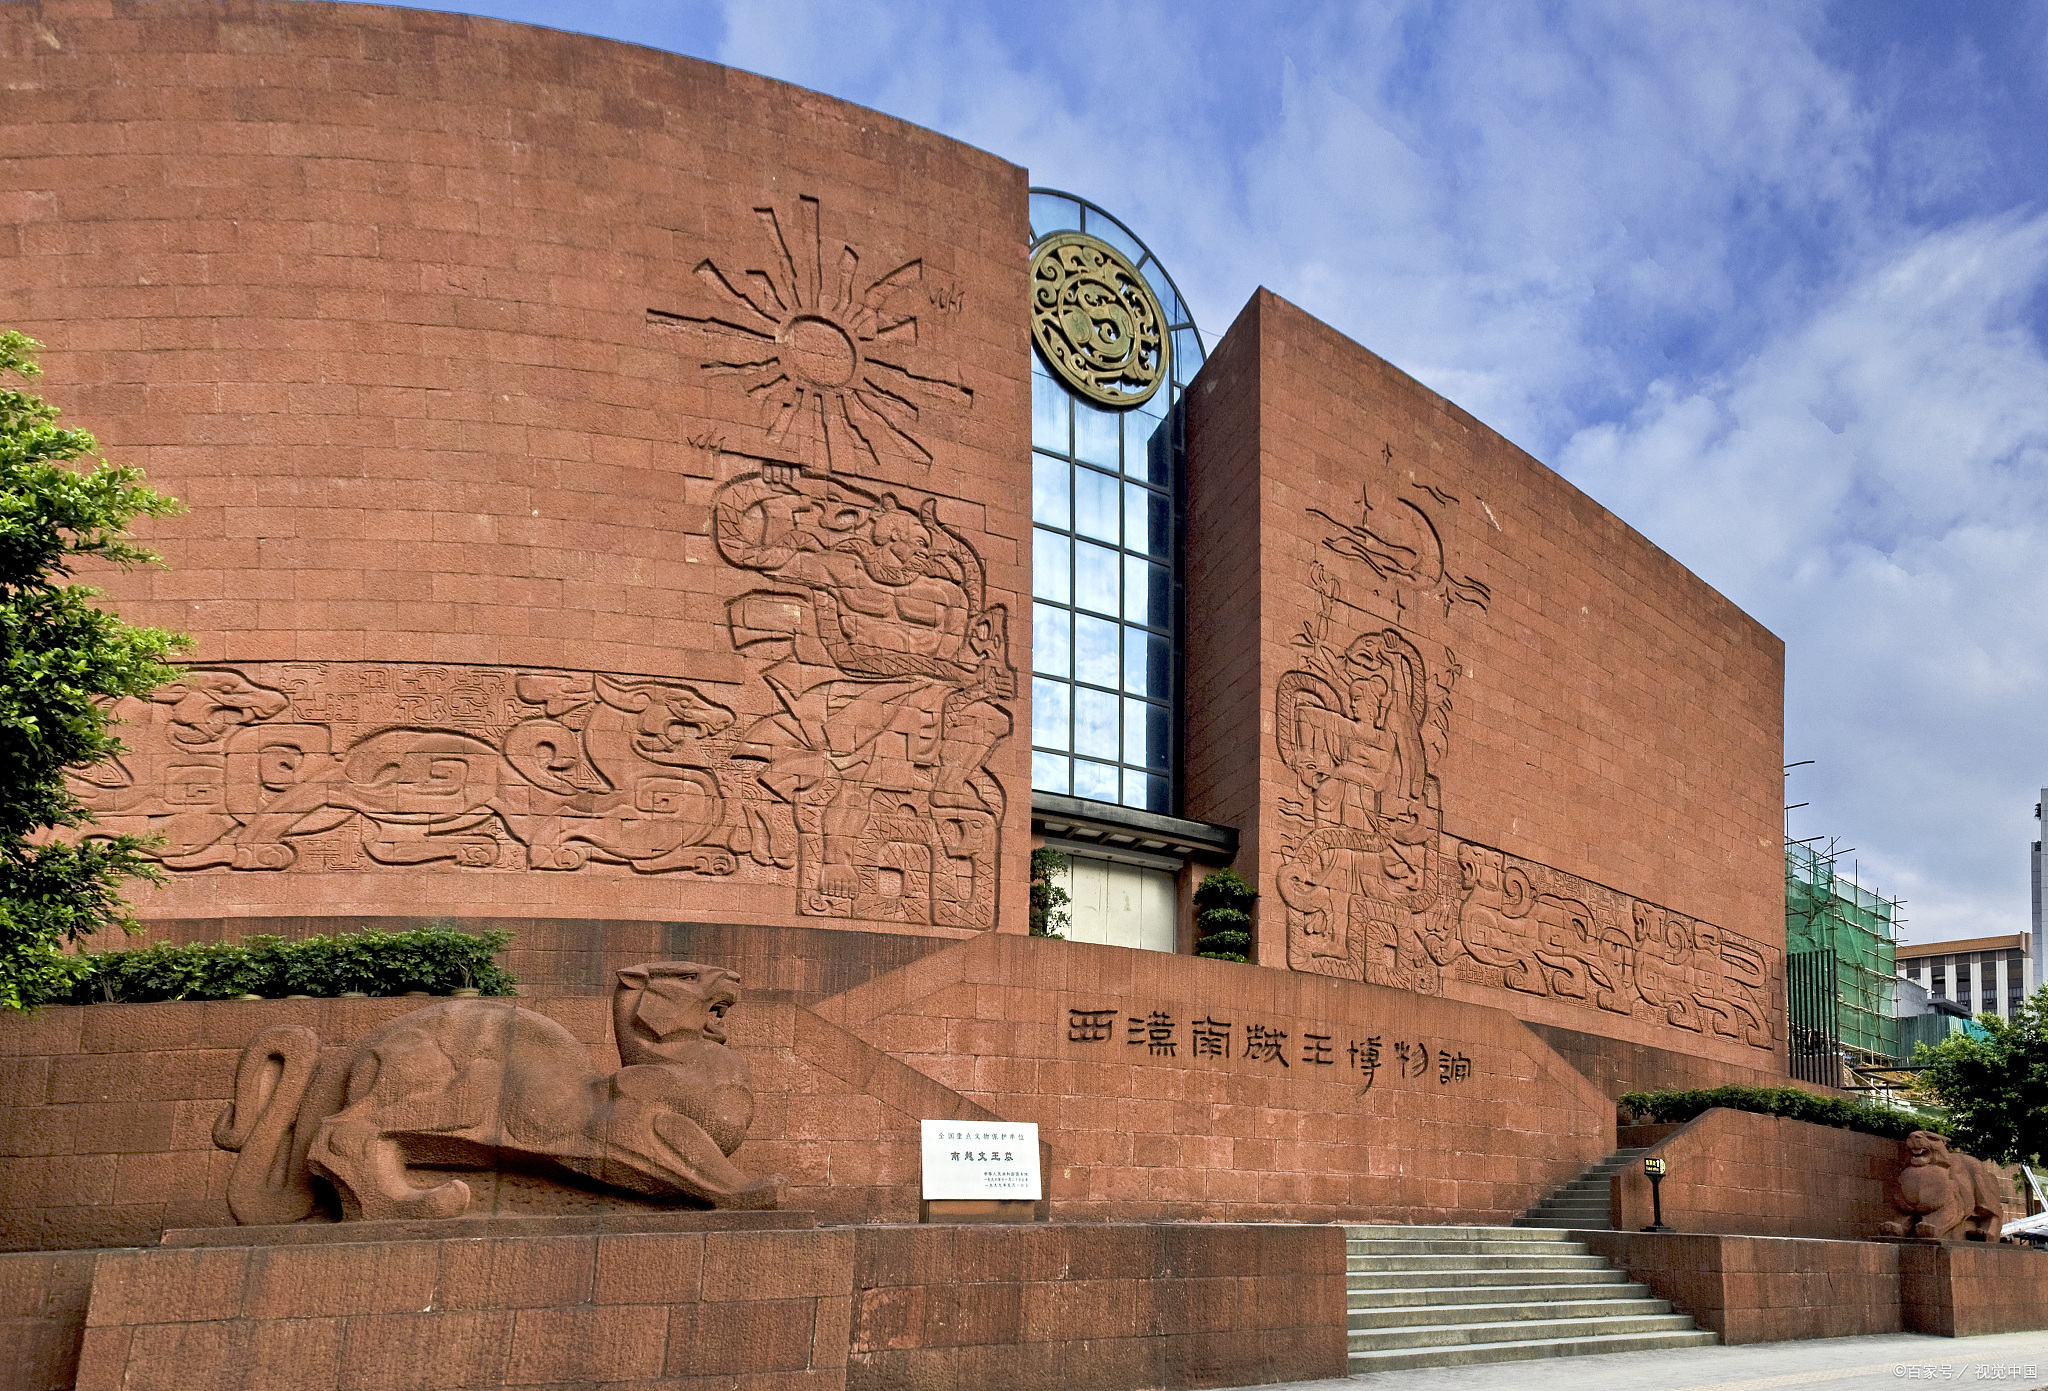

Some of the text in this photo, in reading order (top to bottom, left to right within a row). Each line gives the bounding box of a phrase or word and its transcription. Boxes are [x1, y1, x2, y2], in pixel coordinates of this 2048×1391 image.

[938, 1132, 1024, 1140] 全国重点文物保护单位
[950, 1151, 1014, 1162] 南越文王墓
